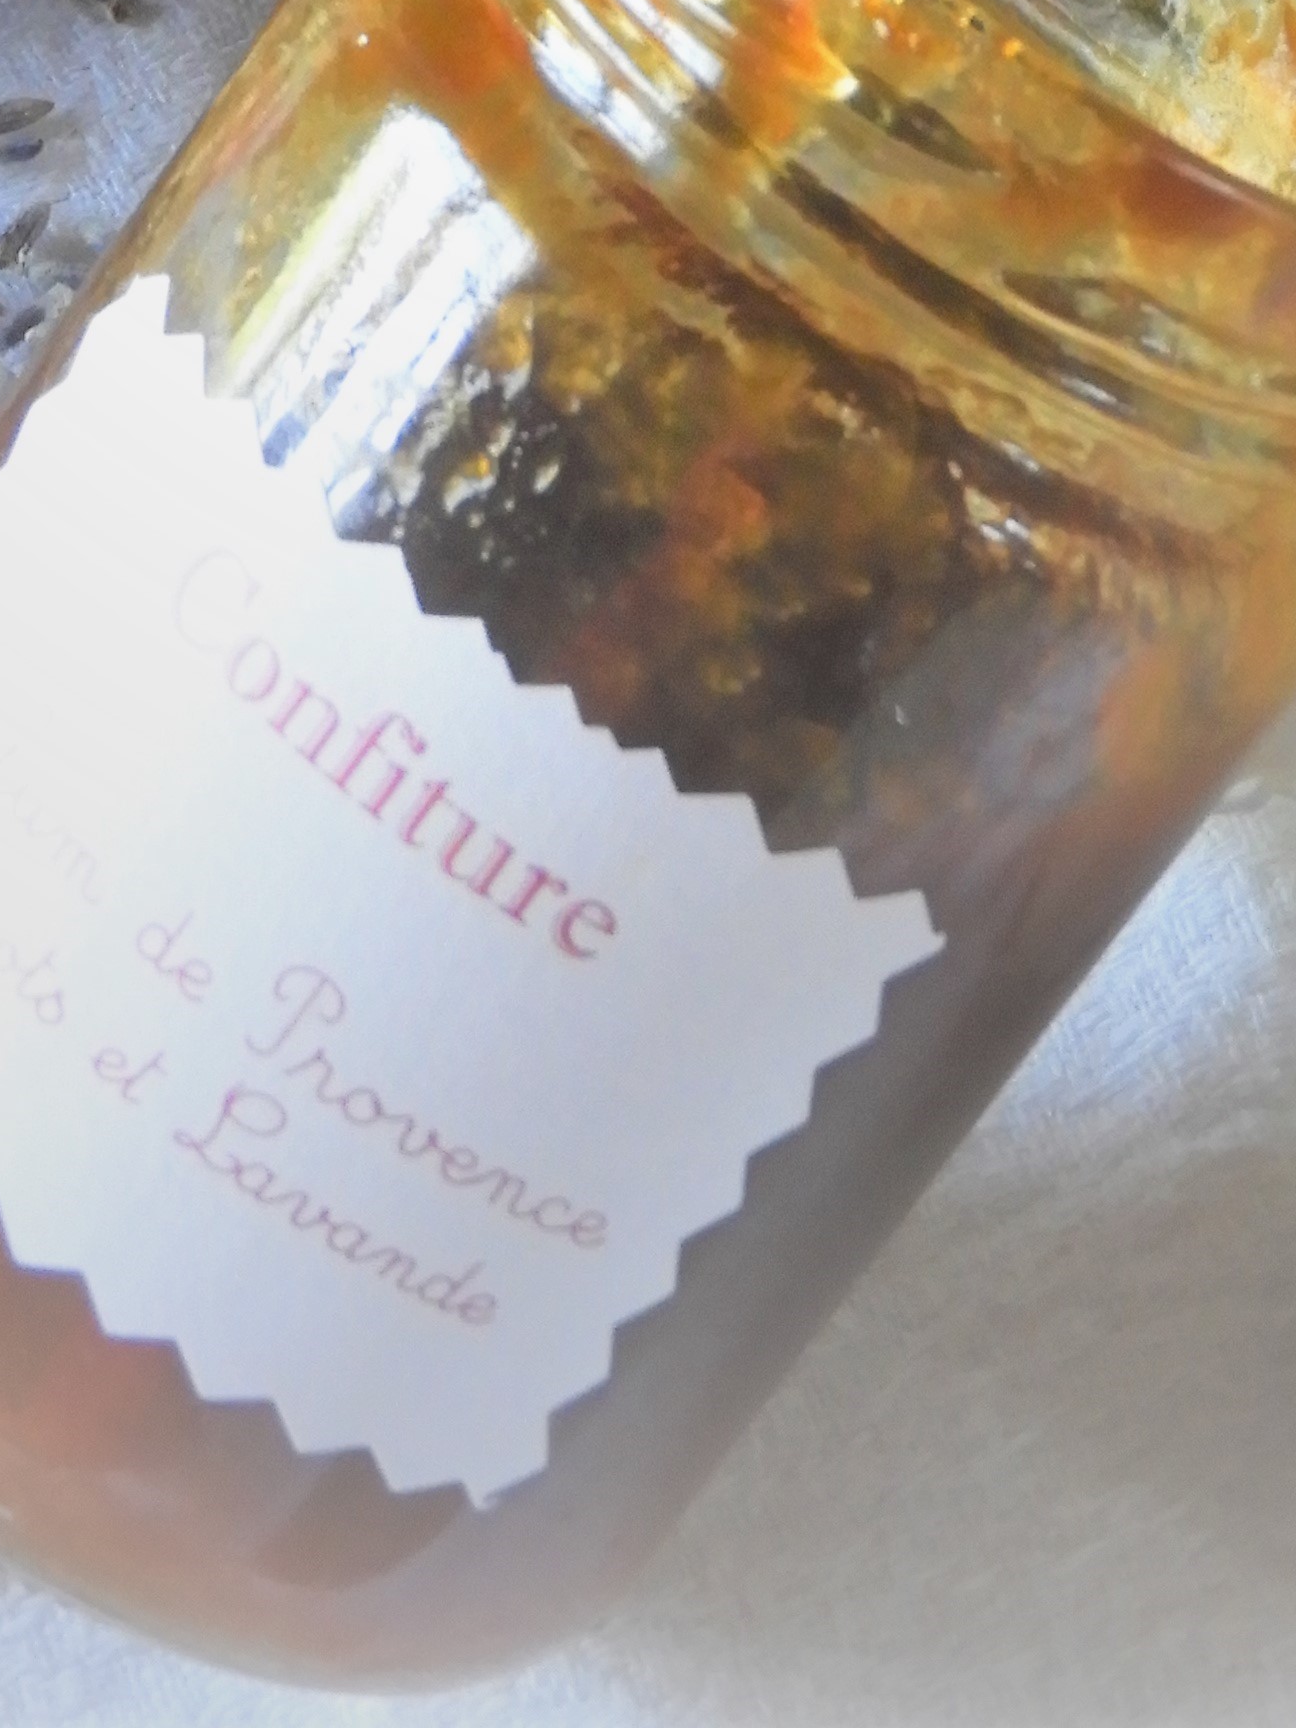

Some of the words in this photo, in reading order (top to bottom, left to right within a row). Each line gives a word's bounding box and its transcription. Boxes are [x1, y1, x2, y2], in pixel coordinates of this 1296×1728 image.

[173, 546, 621, 964] Confiture
[91, 1043, 169, 1105] et
[169, 1080, 499, 1327] Lavande
[133, 910, 215, 1005] de
[242, 962, 608, 1251] Provence
